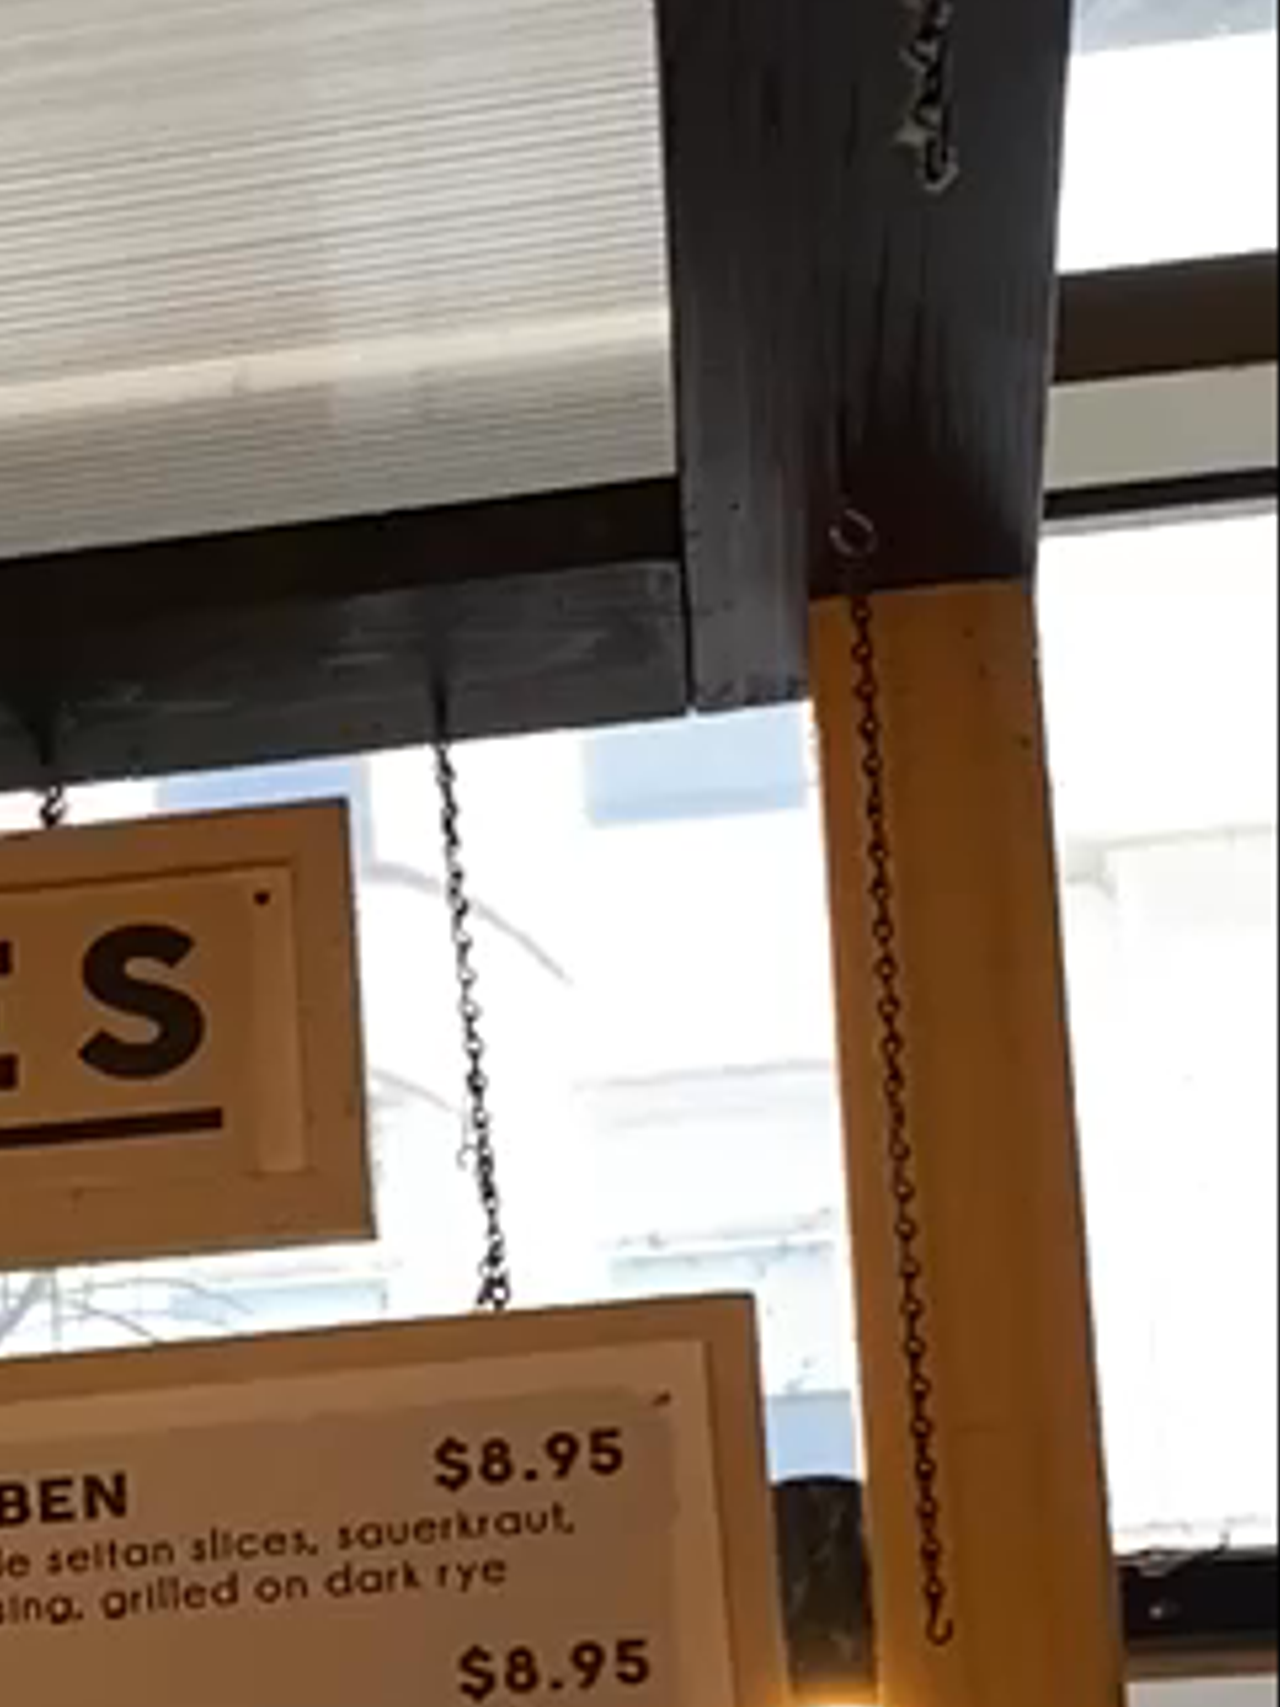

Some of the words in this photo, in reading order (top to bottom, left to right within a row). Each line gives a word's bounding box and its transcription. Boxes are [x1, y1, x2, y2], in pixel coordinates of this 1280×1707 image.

[431, 1424, 626, 1496] $8.95
[44, 1537, 177, 1578] seitan
[456, 1636, 652, 1706] $8.95
